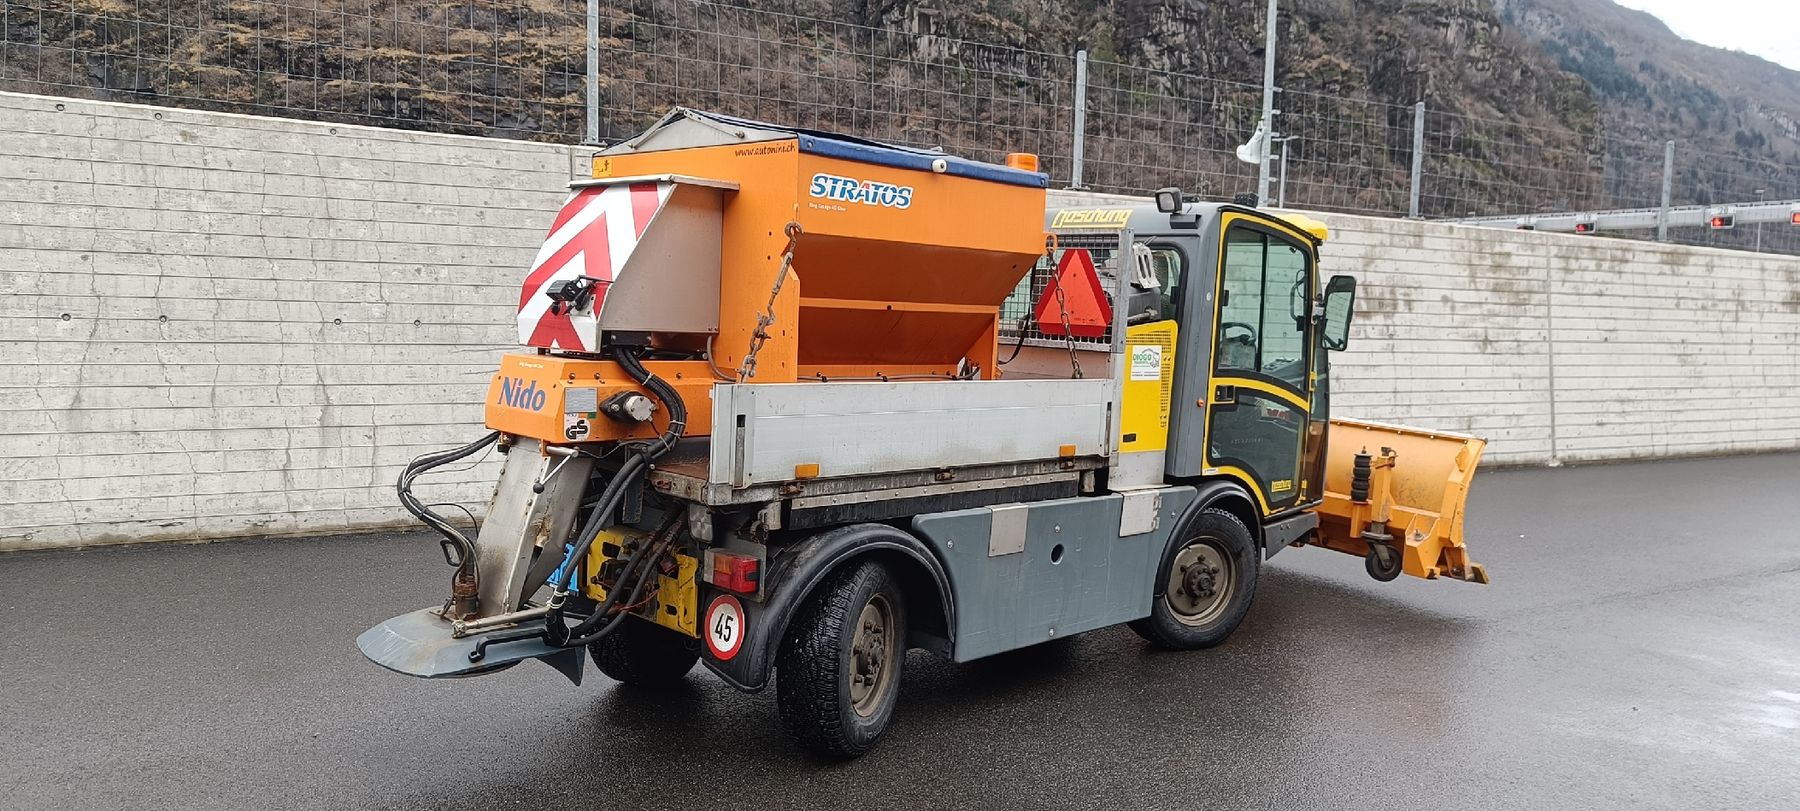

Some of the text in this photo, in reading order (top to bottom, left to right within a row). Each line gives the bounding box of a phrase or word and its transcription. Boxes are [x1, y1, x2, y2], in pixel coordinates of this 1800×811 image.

[735, 142, 795, 157] www.autonini.ch
[810, 174, 912, 207] STRATOS
[497, 376, 546, 412] Nido
[565, 419, 589, 440] GS
[715, 613, 734, 642] 45
